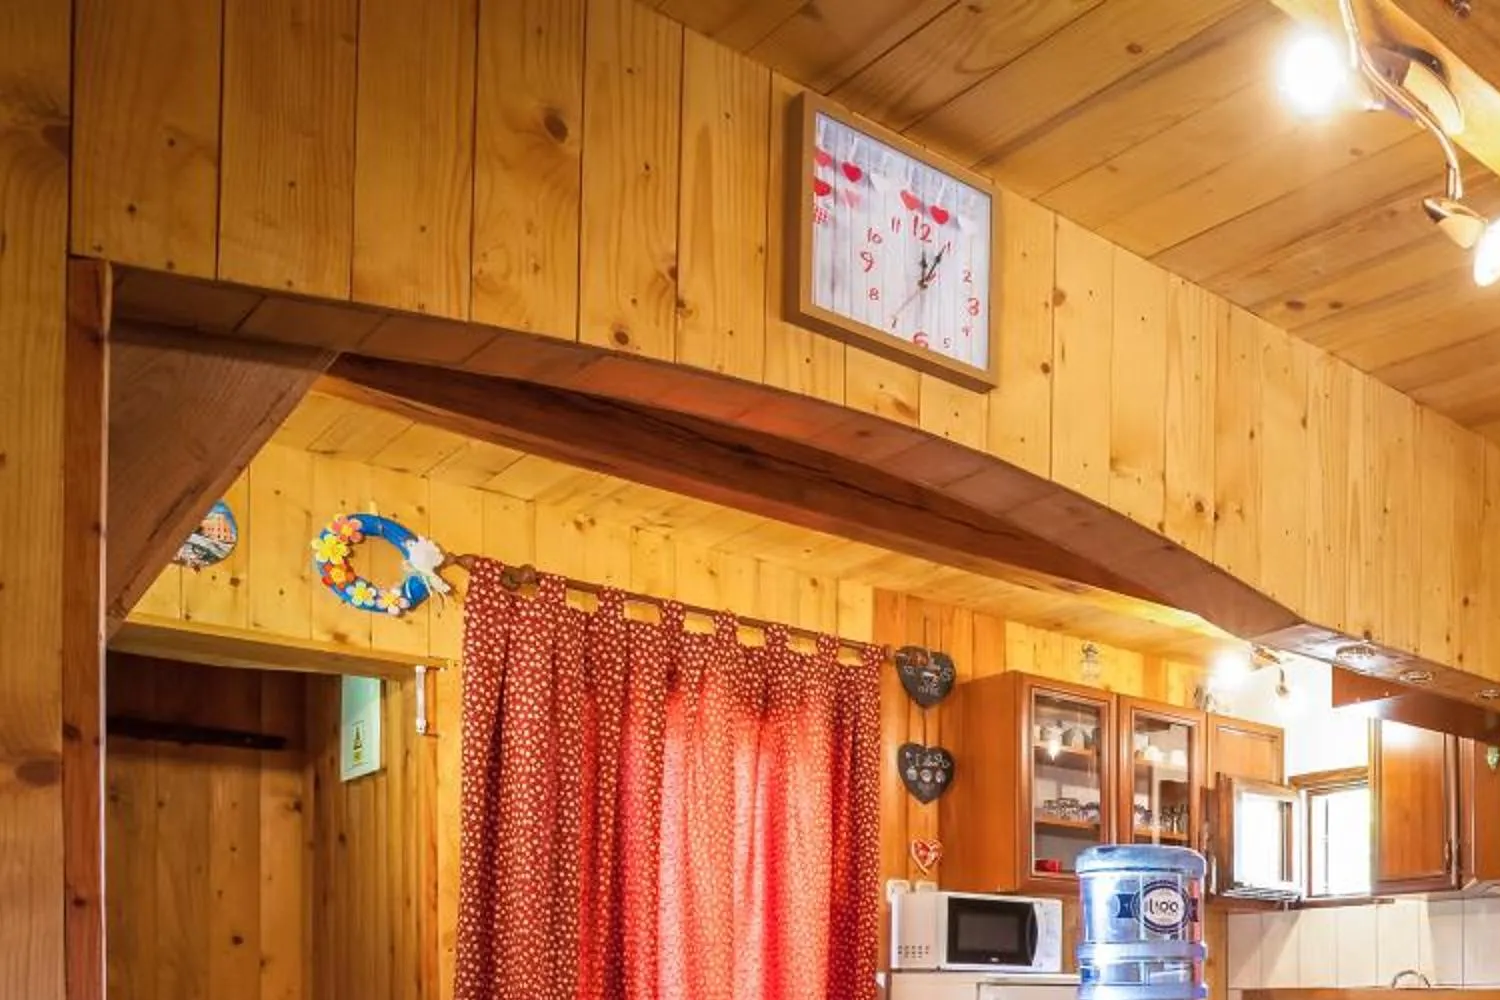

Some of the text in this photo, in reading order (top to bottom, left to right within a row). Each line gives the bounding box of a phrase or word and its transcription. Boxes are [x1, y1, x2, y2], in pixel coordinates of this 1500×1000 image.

[891, 216, 901, 234] 11
[914, 215, 932, 243] 12
[867, 227, 883, 244] 10
[861, 251, 874, 272] 9
[963, 270, 973, 283] 2
[869, 287, 879, 301] 8
[967, 297, 980, 317] 3
[913, 331, 929, 347] 6
[943, 337, 952, 349] 5
